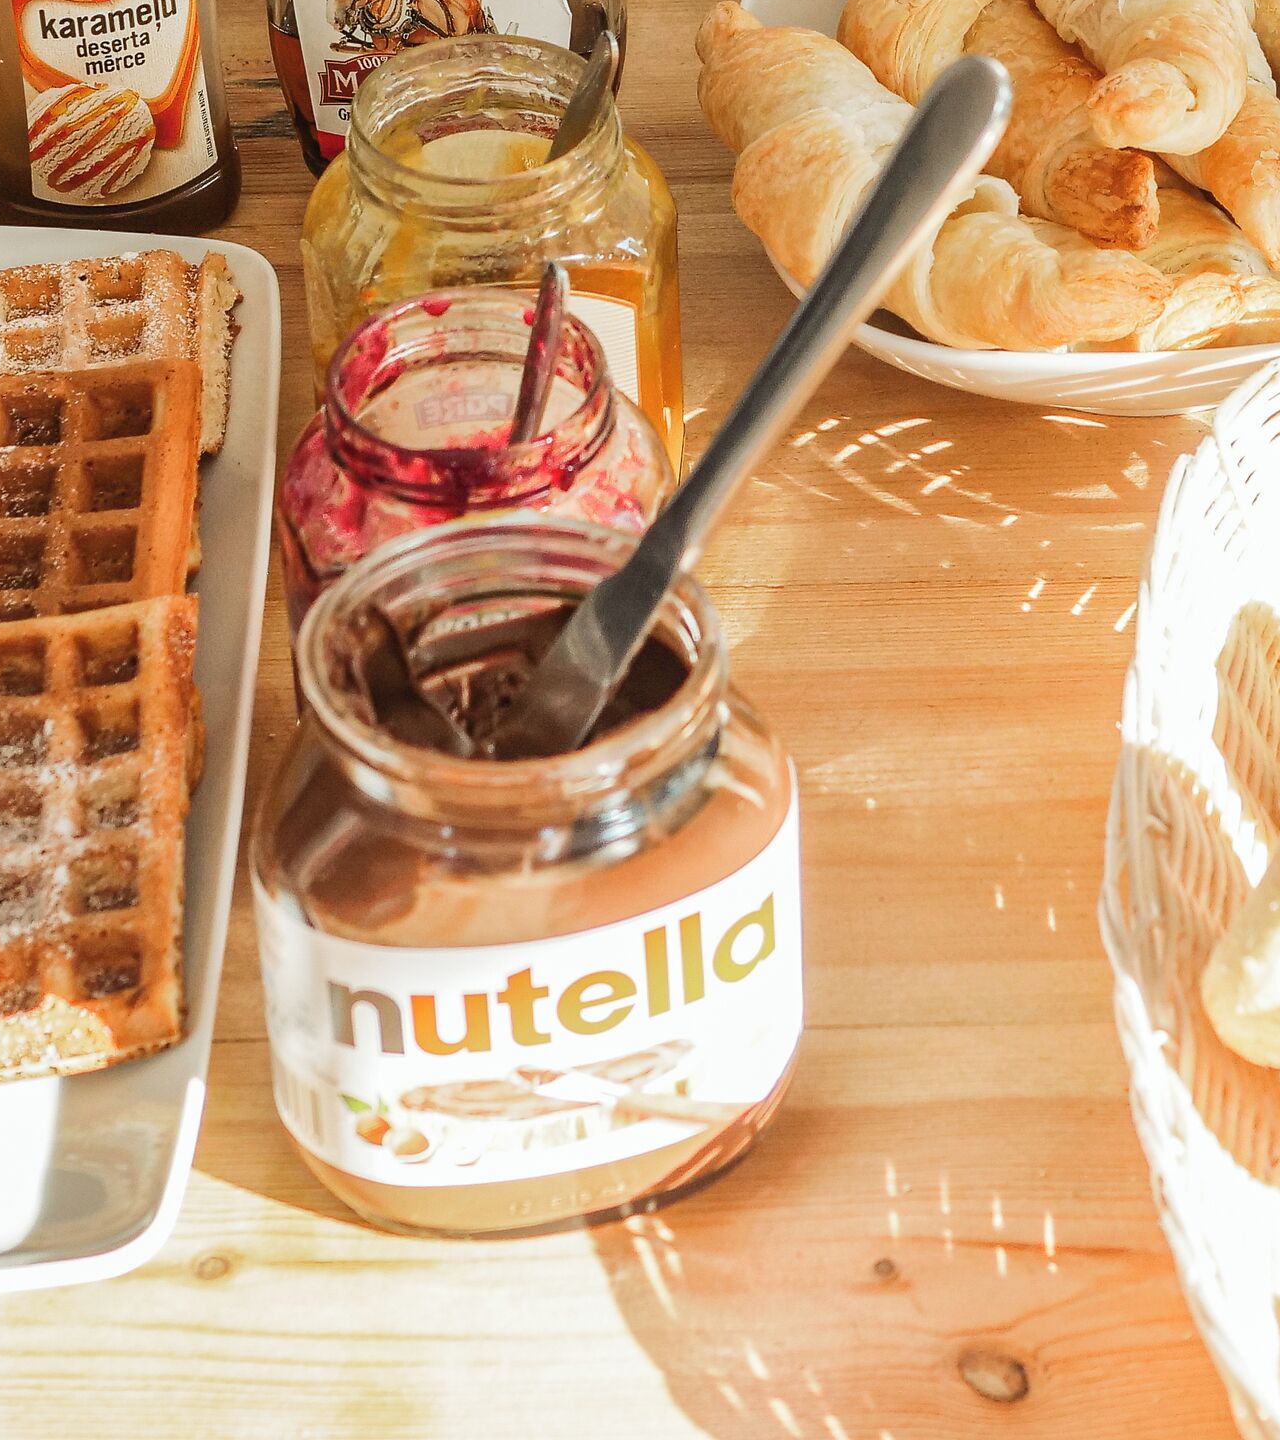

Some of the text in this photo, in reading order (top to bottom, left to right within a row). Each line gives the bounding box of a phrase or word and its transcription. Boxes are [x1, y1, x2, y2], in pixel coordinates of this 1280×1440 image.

[76, 31, 150, 59] deserta
[86, 49, 146, 75] mērce
[328, 891, 776, 1056] nutella
